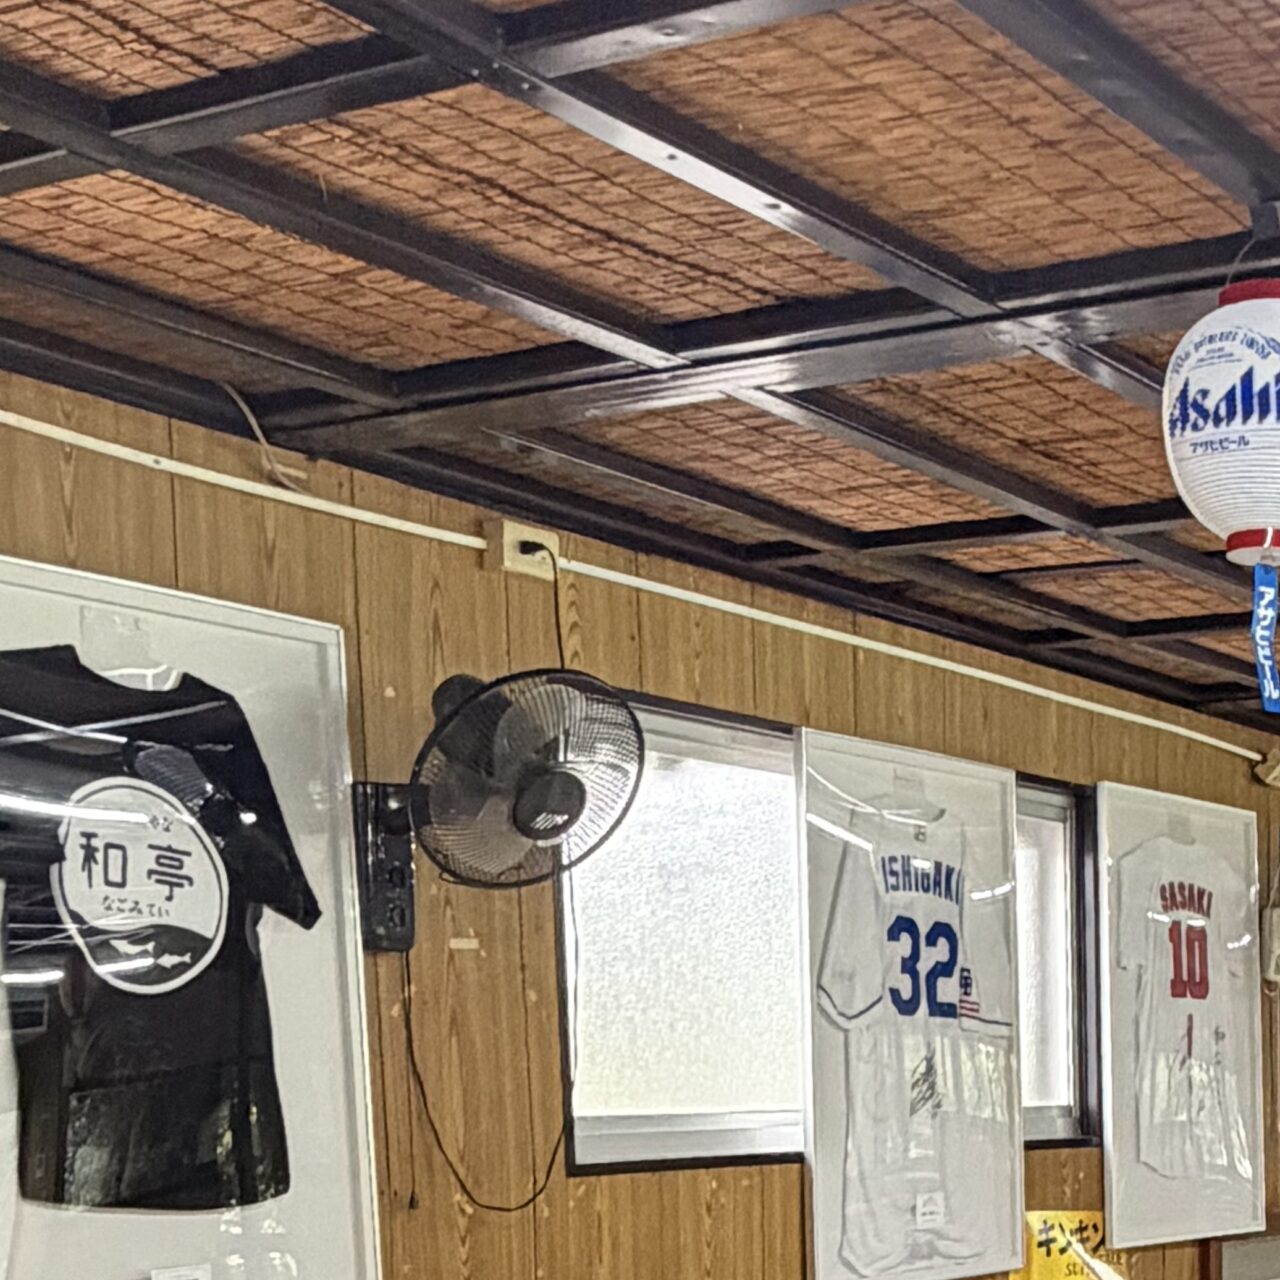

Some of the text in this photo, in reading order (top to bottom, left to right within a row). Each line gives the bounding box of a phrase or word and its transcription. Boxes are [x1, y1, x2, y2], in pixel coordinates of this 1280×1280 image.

[1190, 435, 1250, 454] アサヒビール
[1255, 585, 1280, 699] アサヒビール
[78, 831, 195, 902] 和亭
[881, 855, 962, 906] ISHIGAKI
[103, 895, 171, 918] なごみてい
[1160, 881, 1213, 919] SASAKI
[887, 915, 959, 1019] 32
[1168, 920, 1209, 1000] 10
